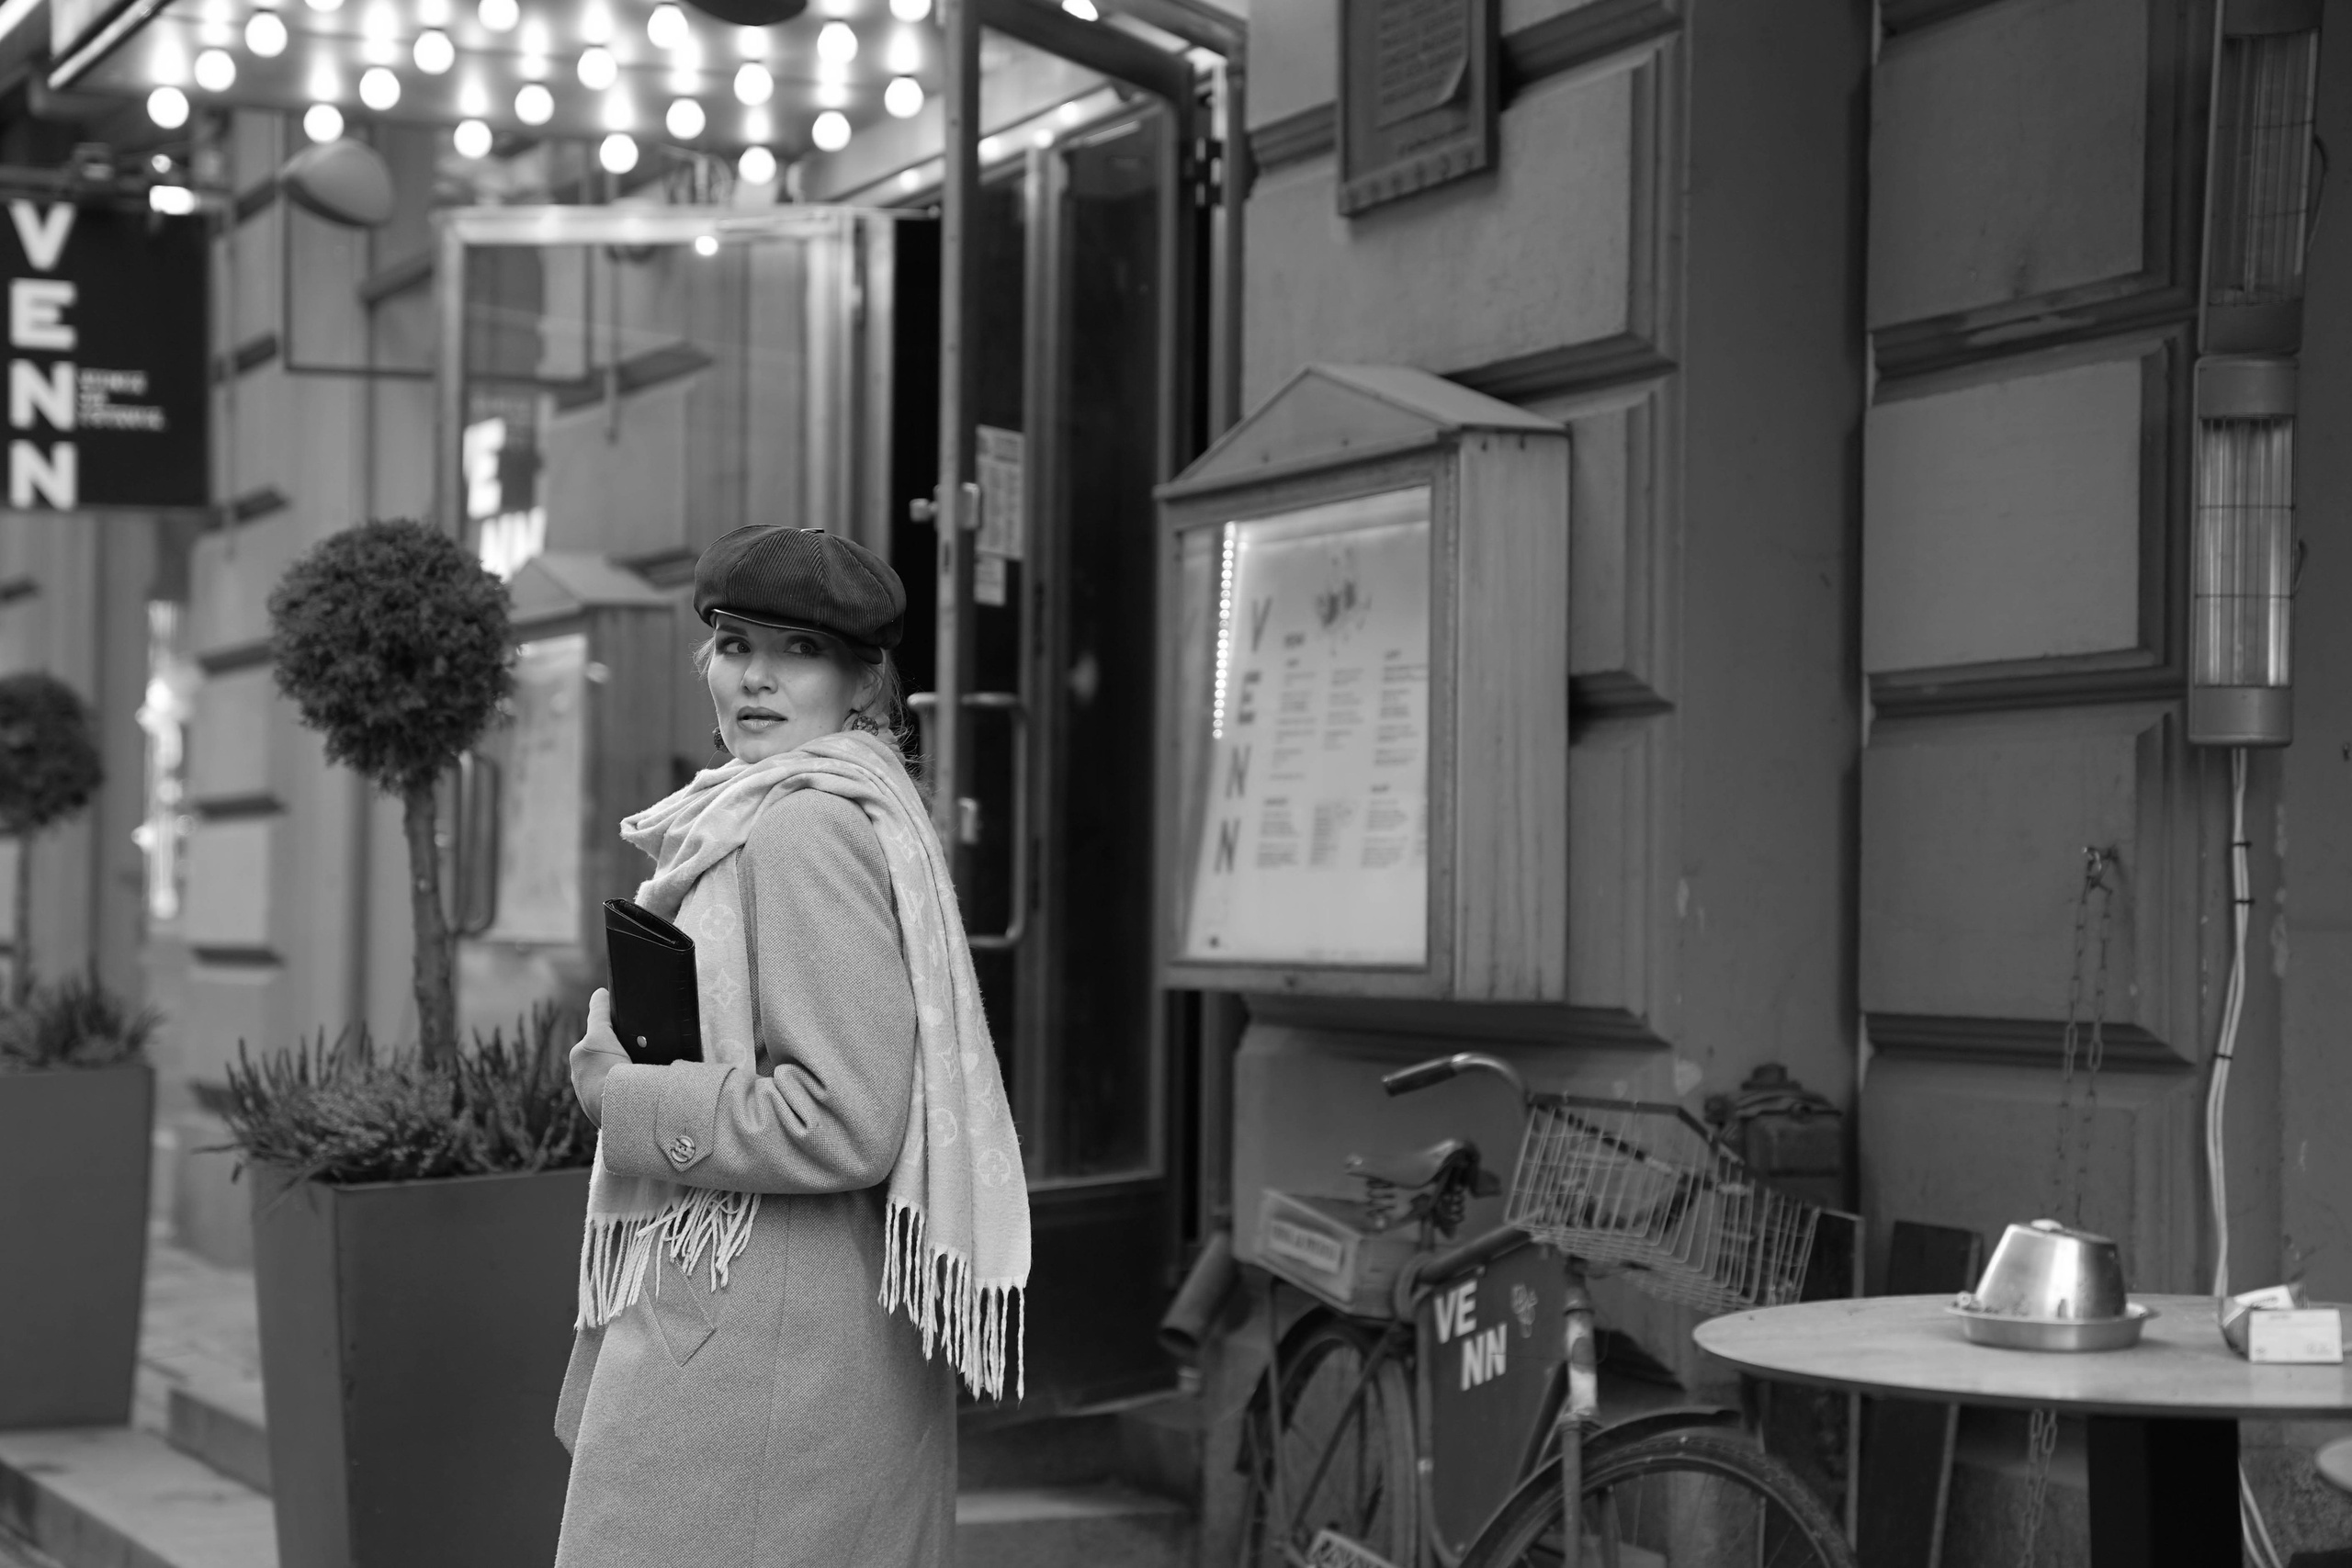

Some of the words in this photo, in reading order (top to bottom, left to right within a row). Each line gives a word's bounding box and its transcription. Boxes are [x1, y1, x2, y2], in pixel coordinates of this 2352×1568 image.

[7, 197, 78, 511] VENN
[1433, 1279, 1477, 1344] VE
[1460, 1321, 1508, 1392] NN
